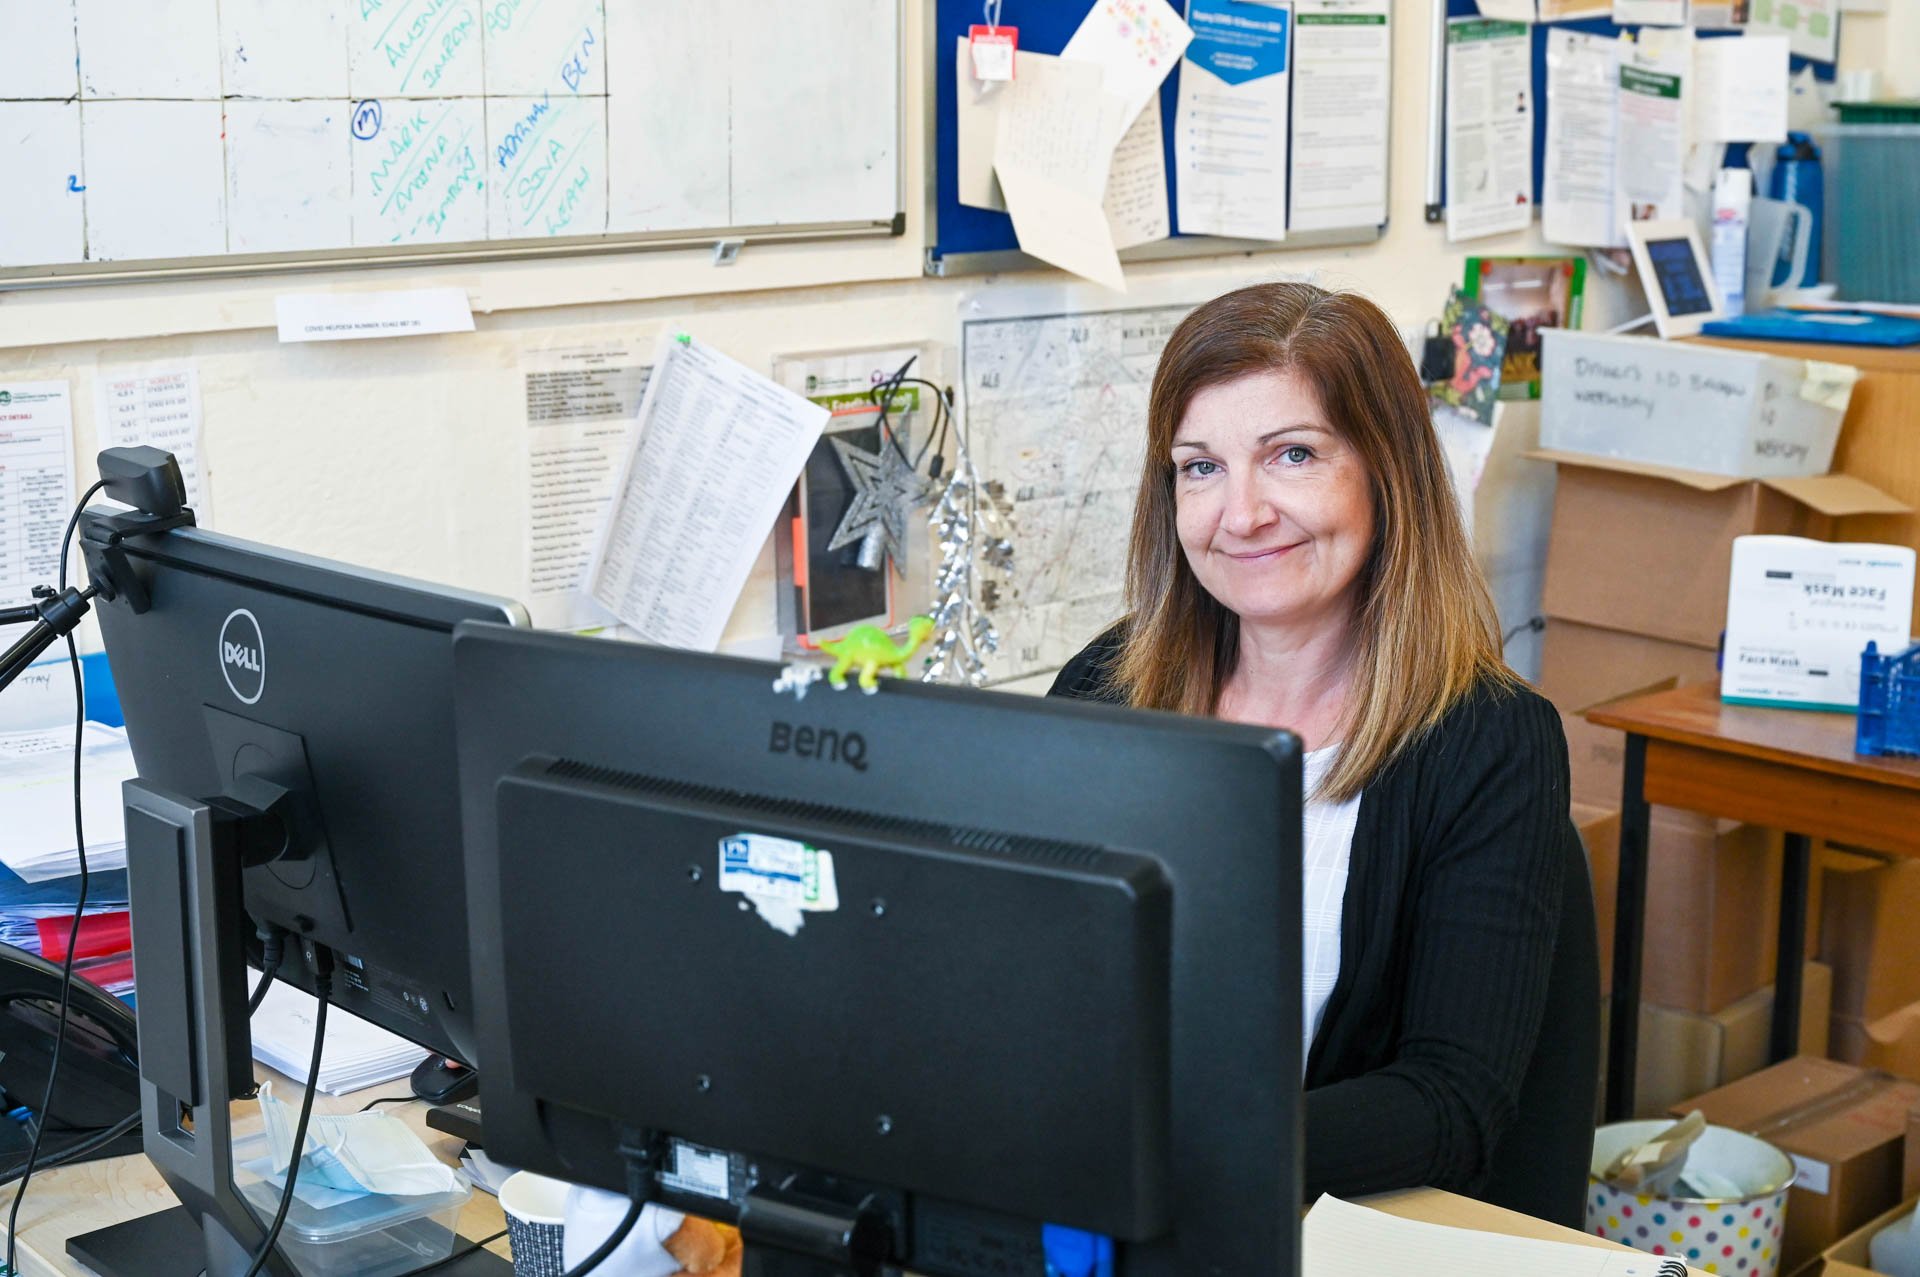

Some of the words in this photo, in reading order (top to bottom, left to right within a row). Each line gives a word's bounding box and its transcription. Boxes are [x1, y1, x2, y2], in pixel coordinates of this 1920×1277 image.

[562, 27, 596, 92] BEN
[368, 108, 429, 192] MARK
[1804, 583, 1846, 598] Mask
[1849, 586, 1887, 602] Face
[224, 641, 260, 672] DELL
[1739, 653, 1766, 665] Face
[1769, 656, 1800, 668] Mask
[769, 721, 869, 772] BenQ
